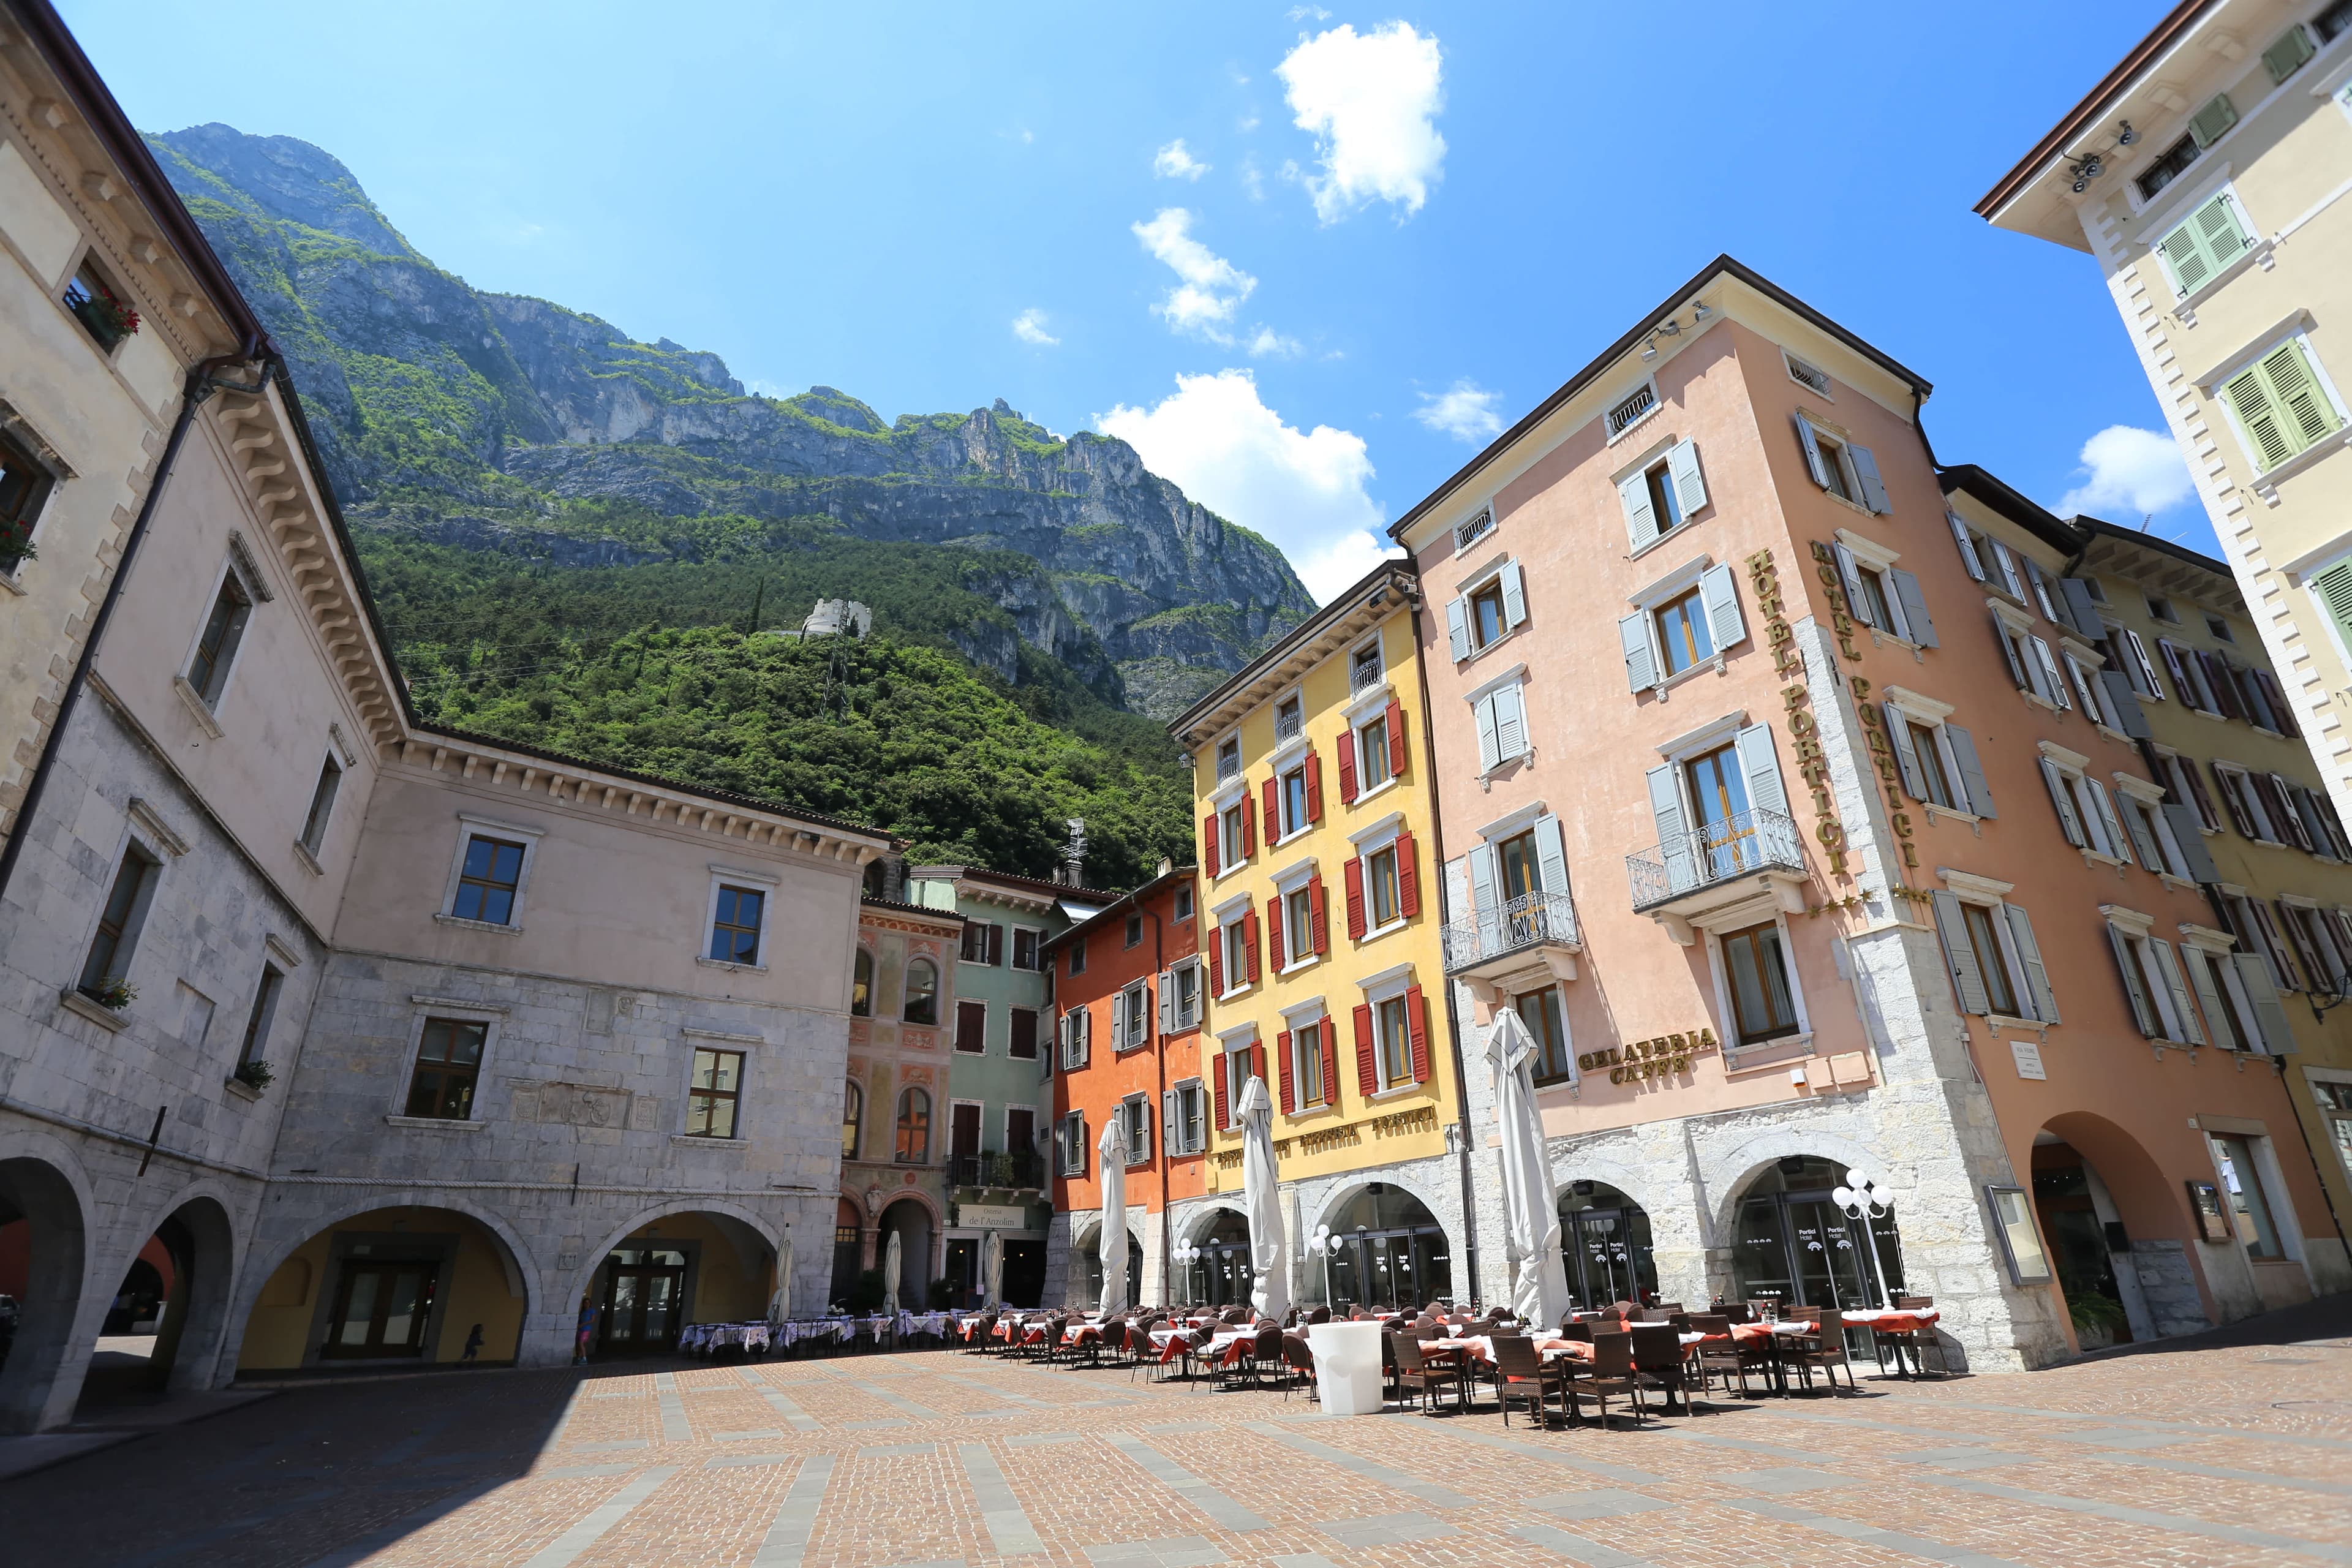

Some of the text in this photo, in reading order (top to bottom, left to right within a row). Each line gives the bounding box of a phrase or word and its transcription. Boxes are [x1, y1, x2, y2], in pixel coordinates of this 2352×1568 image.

[1744, 547, 1846, 875] HOTEL PORTICI
[1809, 540, 1919, 867] HOTEL PORTICI
[1578, 1028, 1717, 1071] GELATERIA
[1372, 1105, 1435, 1131] PORTICI
[969, 1216, 978, 1225] de
